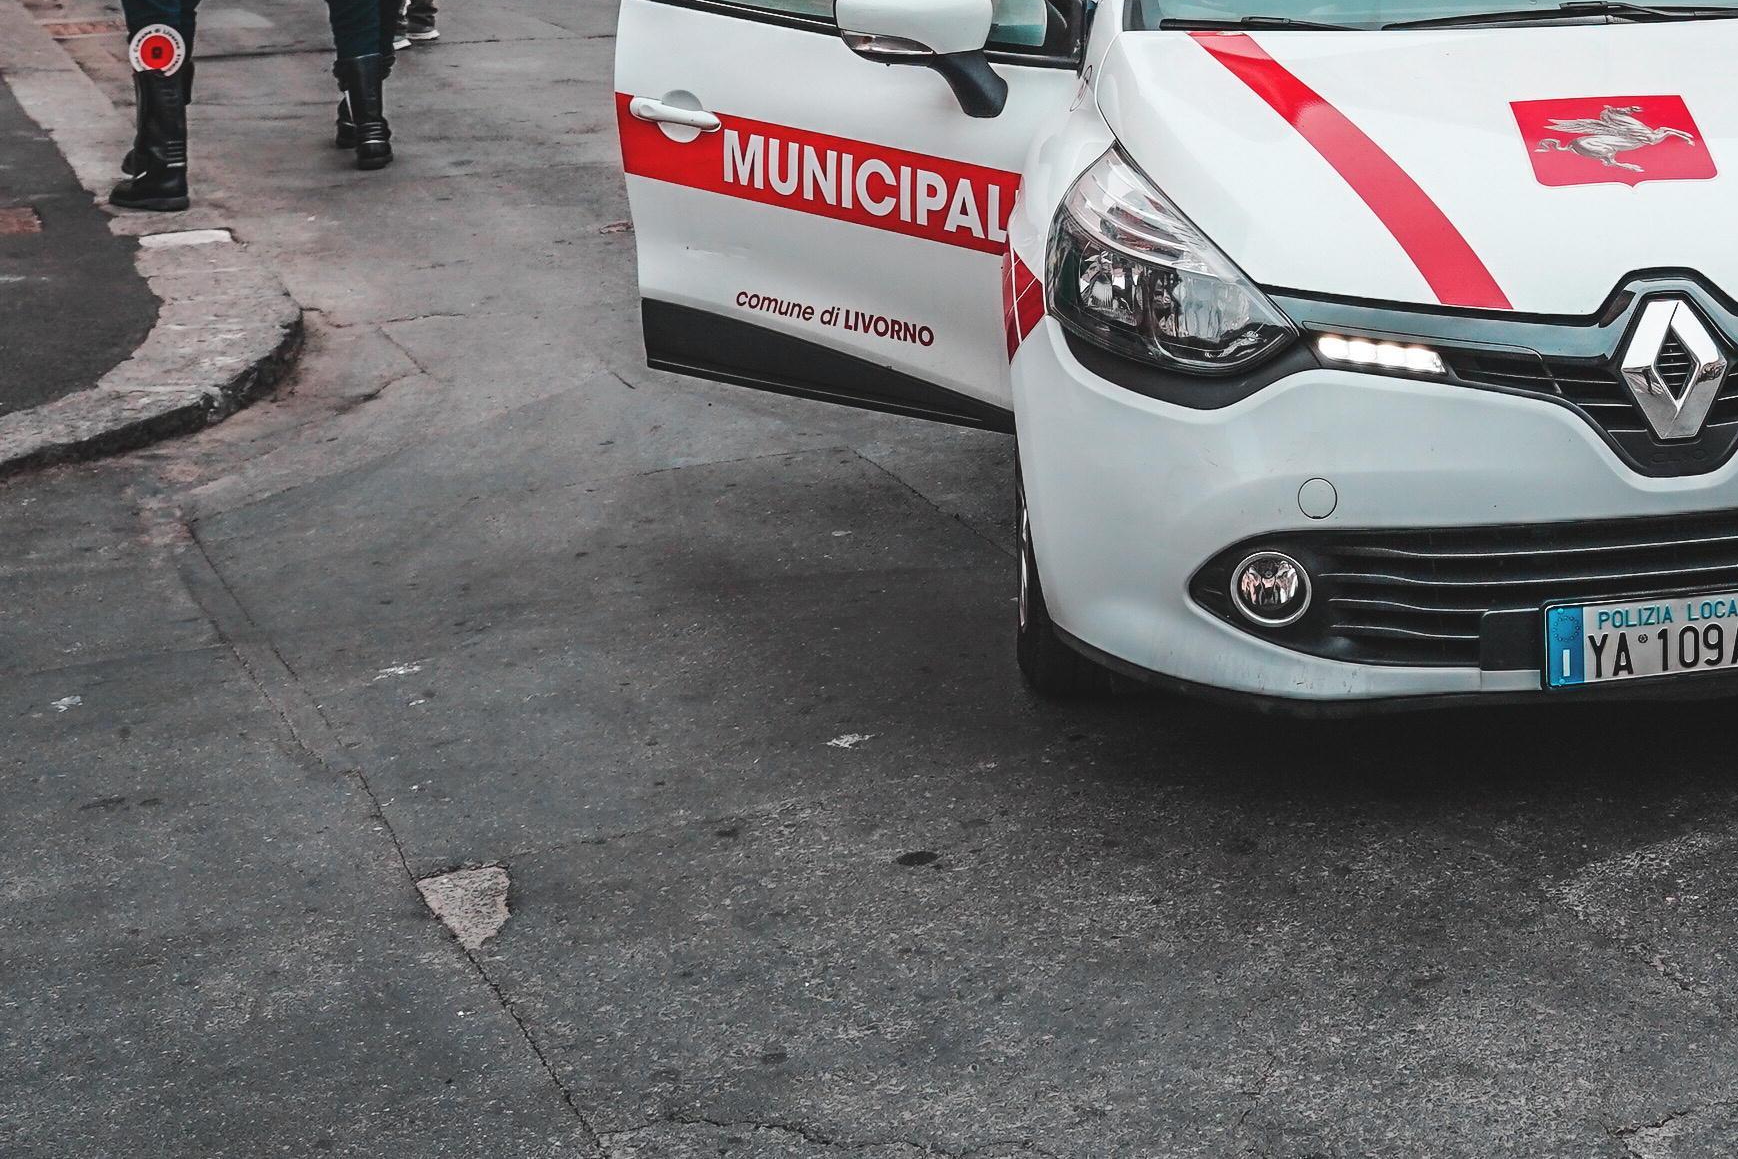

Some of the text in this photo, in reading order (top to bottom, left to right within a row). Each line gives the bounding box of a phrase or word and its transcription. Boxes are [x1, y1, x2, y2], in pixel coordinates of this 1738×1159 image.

[723, 128, 1019, 243] MUNICIPAL
[736, 290, 934, 347] comune di LIVORNO
[1598, 604, 1674, 630] POLIZIA
[1587, 631, 1635, 679] YA
